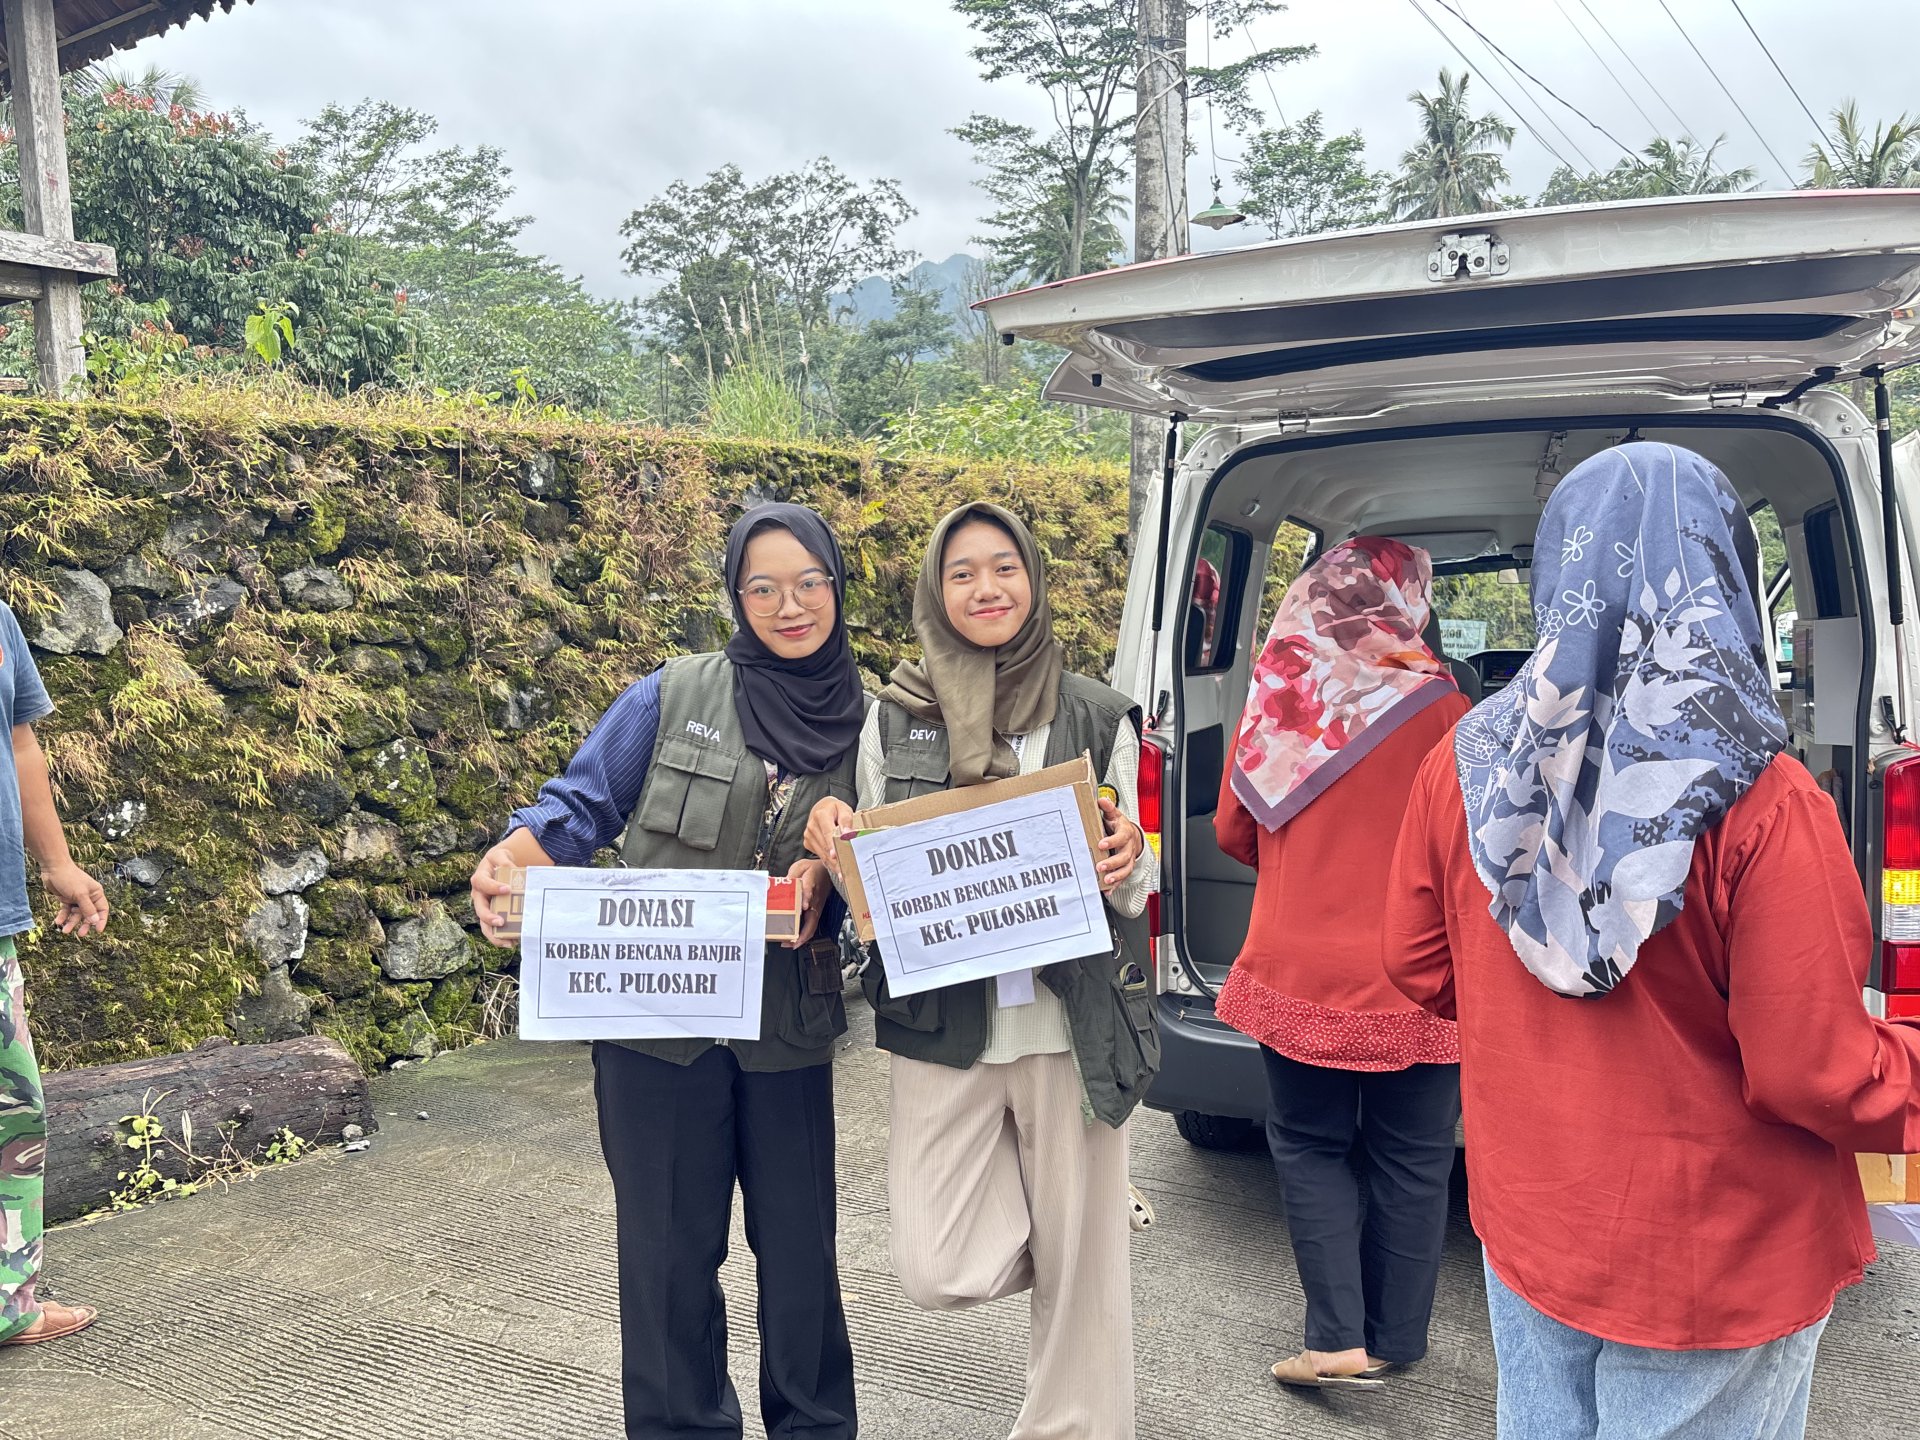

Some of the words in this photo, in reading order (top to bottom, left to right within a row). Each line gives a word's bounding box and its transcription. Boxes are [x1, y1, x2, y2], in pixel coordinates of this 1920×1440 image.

[686, 720, 720, 742] REVA
[910, 729, 937, 741] DEVI
[926, 830, 1019, 876] DONASI
[890, 890, 952, 919] KORBAN
[954, 876, 1019, 904] BENCANA
[1020, 862, 1074, 888] BANJIR
[598, 898, 695, 928] DONASI
[919, 920, 963, 946] KEC.
[965, 895, 1060, 935] PULOSARI
[545, 942, 610, 960] KORBAN
[615, 944, 682, 961] BENCANA
[687, 945, 742, 964] BANJIR
[568, 971, 612, 993] KEC.
[619, 972, 718, 994] PULOSARI
